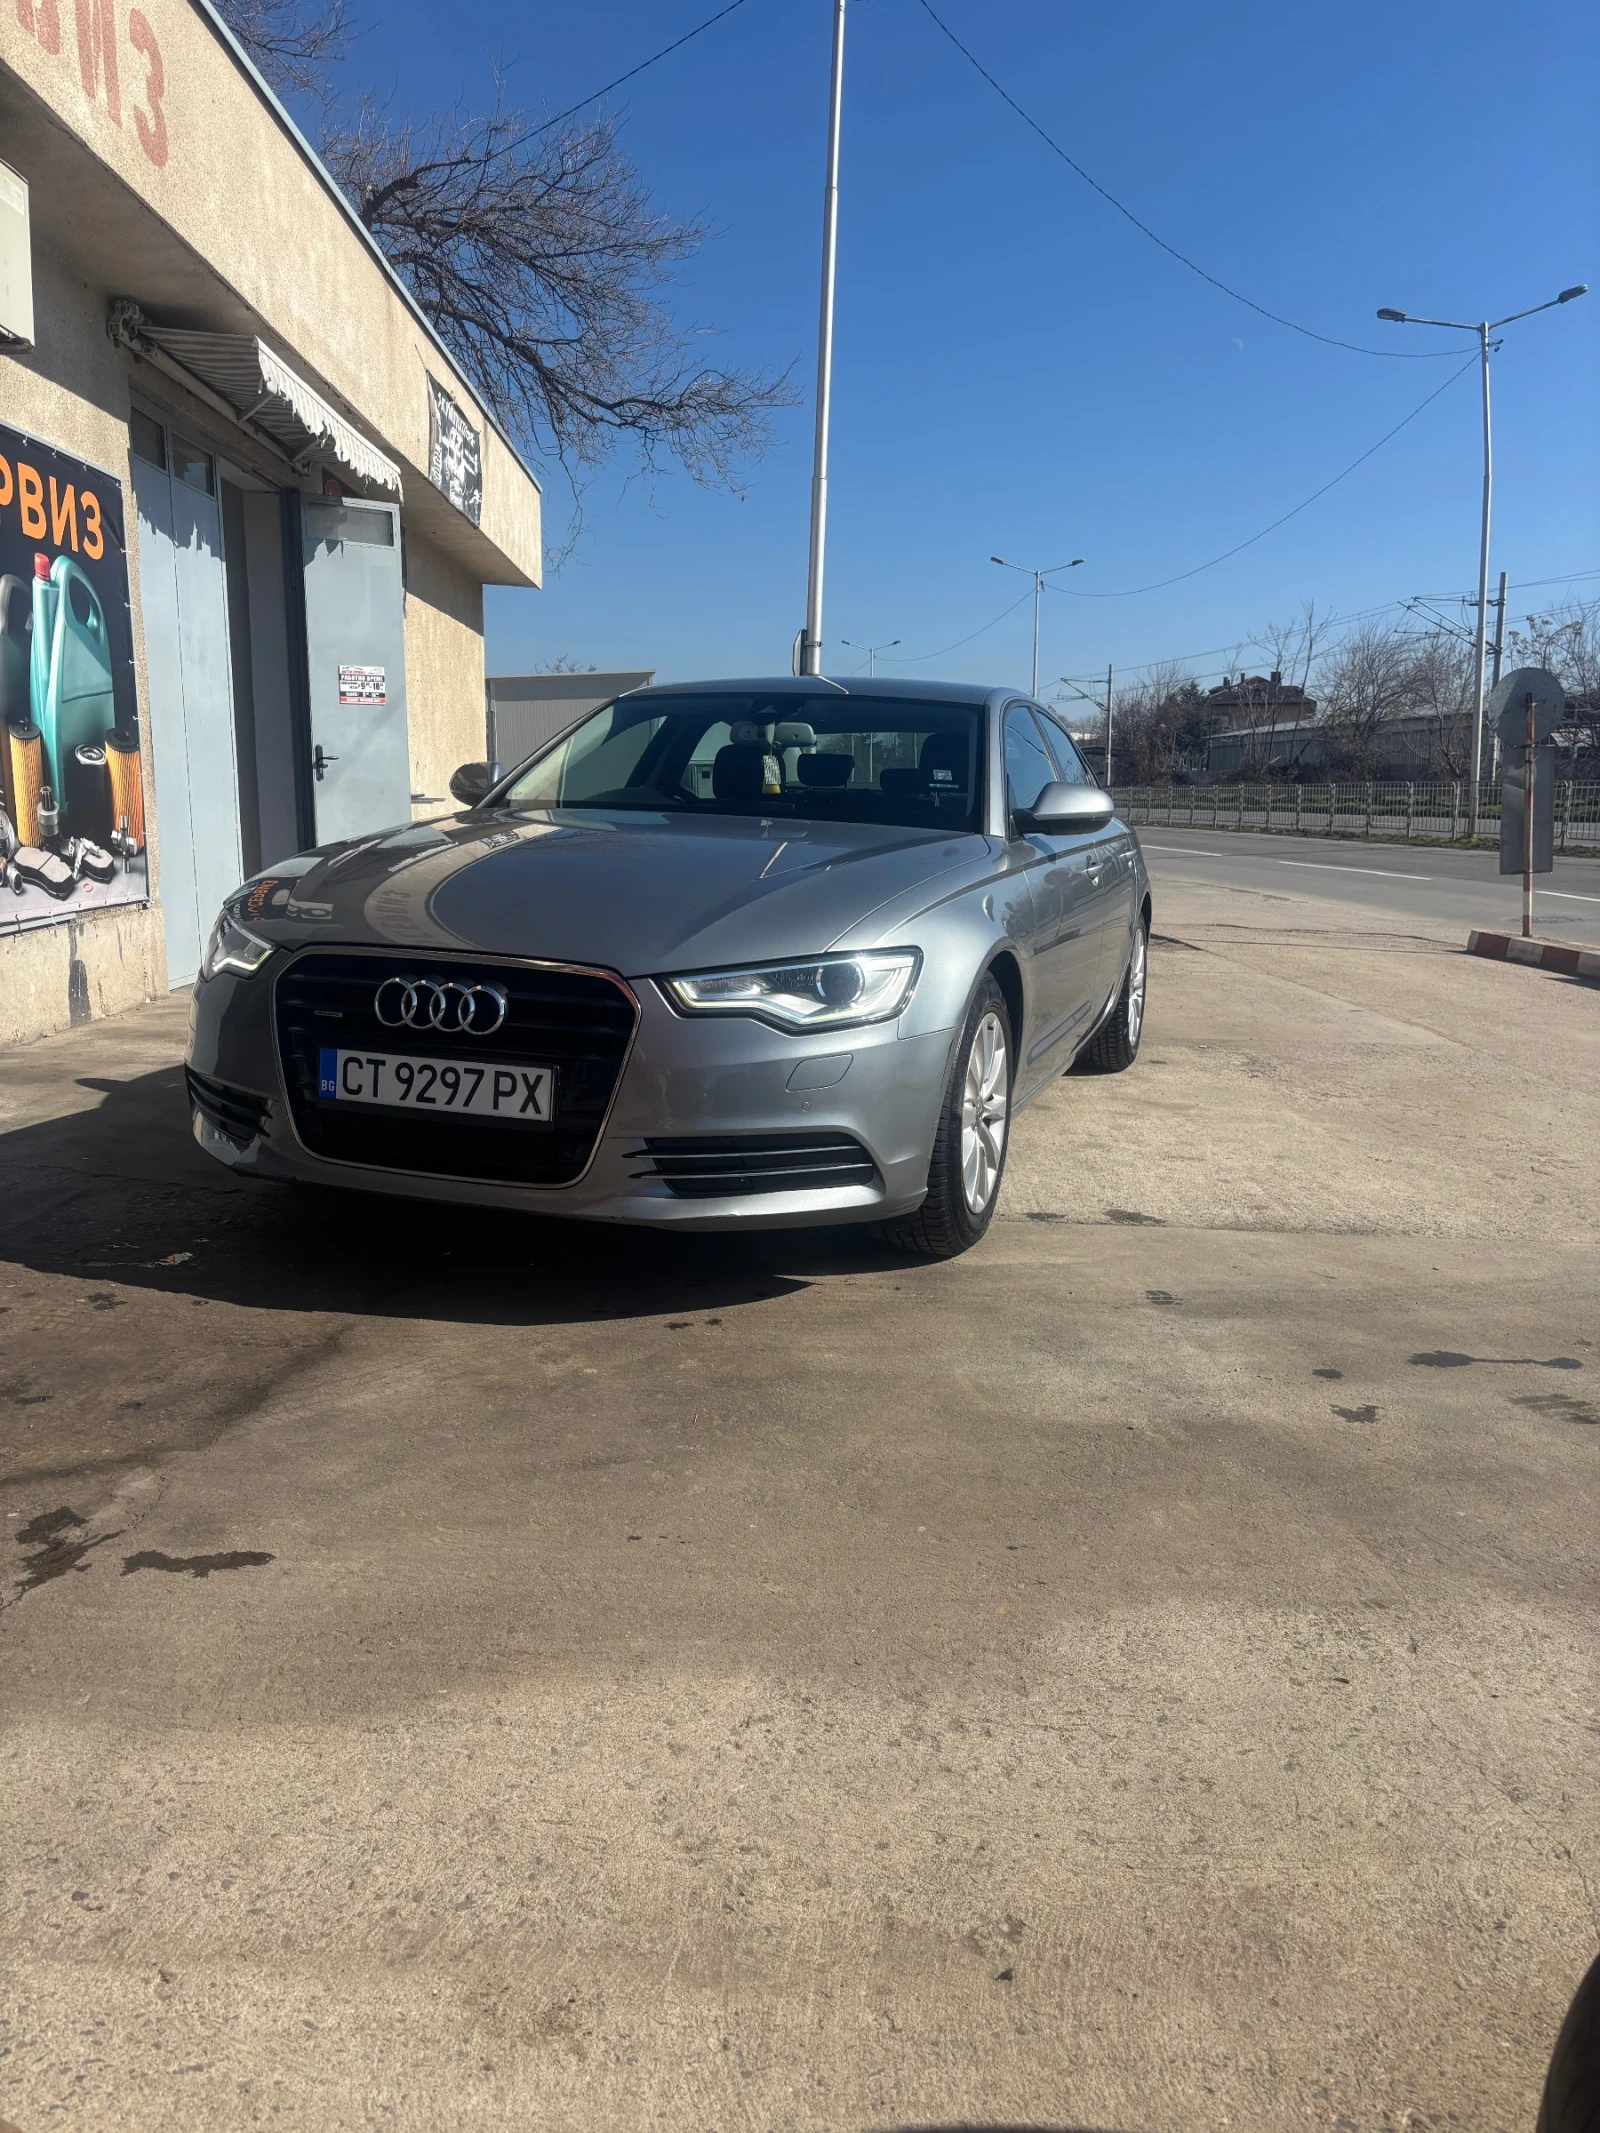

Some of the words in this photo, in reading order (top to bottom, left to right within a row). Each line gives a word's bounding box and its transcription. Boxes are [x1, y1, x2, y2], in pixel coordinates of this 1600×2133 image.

[17, 0, 169, 168] ИЗ
[321, 1080, 335, 1092] BG
[342, 1057, 387, 1098] CT
[395, 1062, 485, 1107] 9297
[493, 1071, 544, 1115] PX
